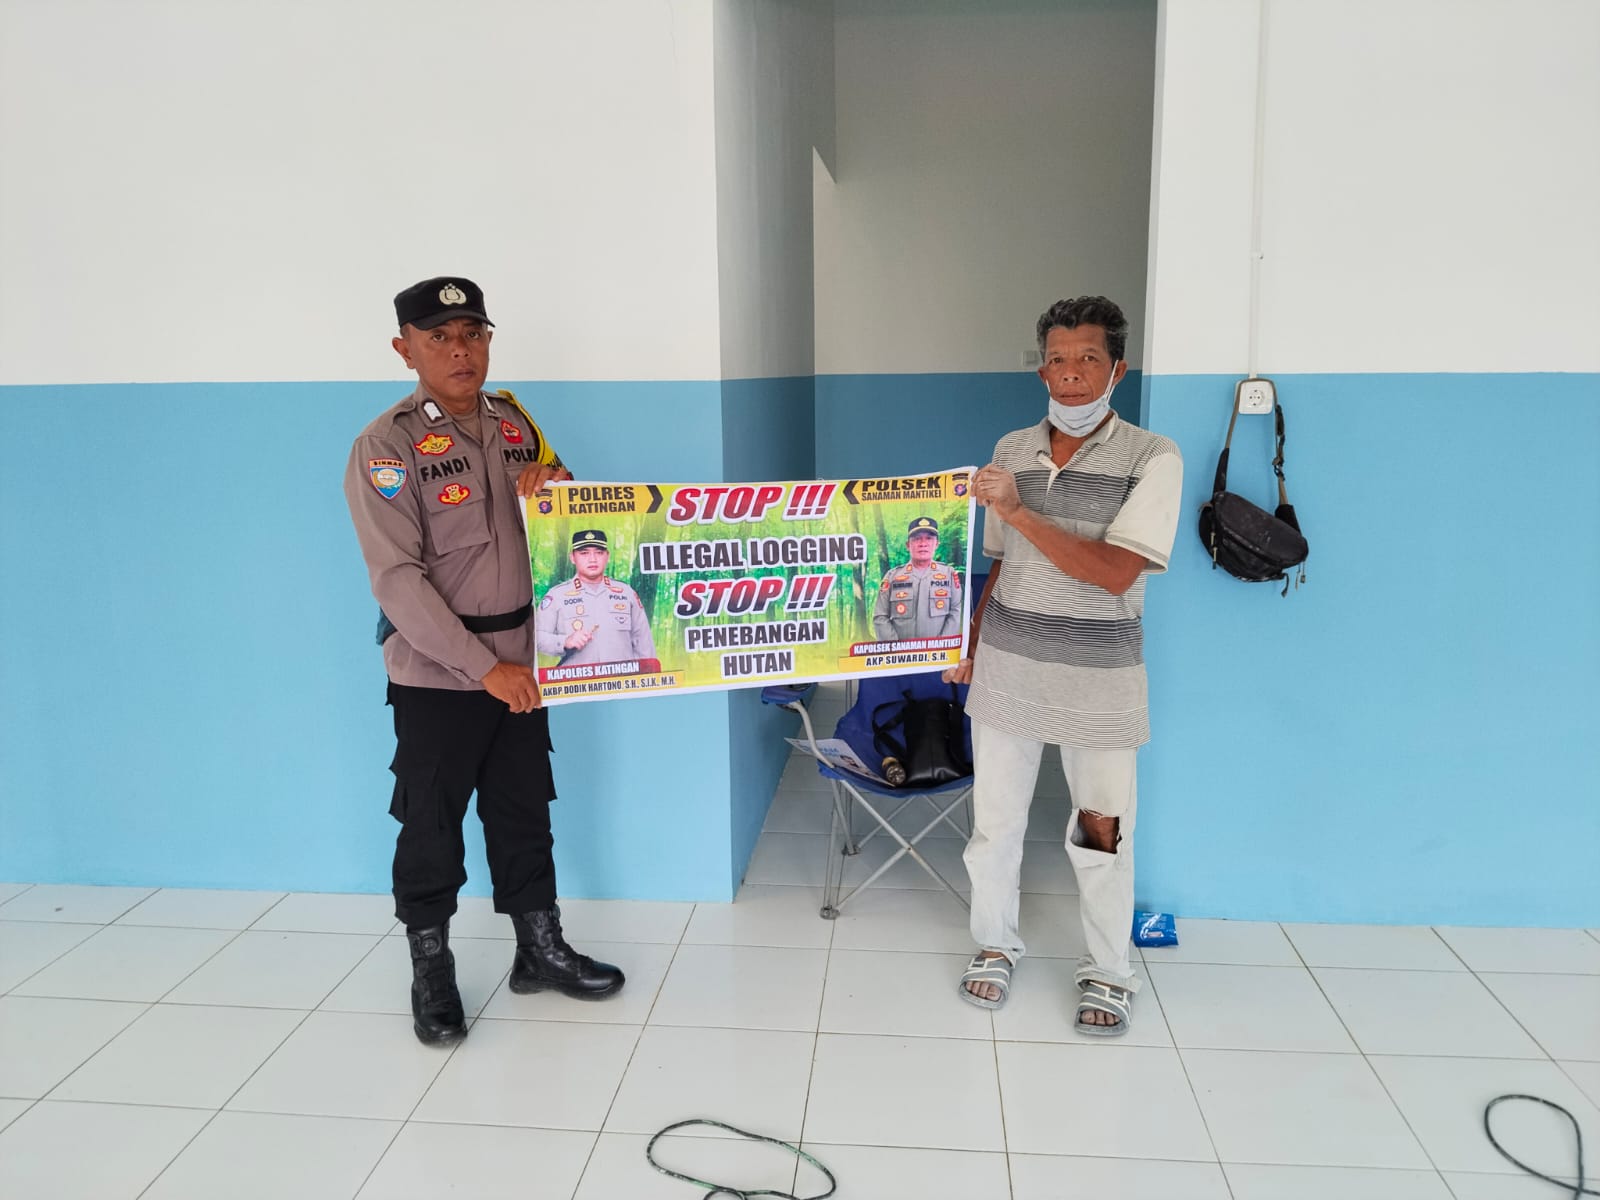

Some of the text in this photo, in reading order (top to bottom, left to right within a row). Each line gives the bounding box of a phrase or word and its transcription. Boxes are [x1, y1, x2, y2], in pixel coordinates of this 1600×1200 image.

[421, 456, 471, 482] FANDI
[862, 476, 941, 492] POLSEK
[568, 486, 634, 502] POLRES
[671, 484, 836, 521] STOP !!!
[862, 489, 941, 501] SANAMAN MANTIKEI
[569, 501, 635, 514] KATINGAN
[643, 536, 864, 571] ILLEGAL LOGGING
[677, 576, 833, 616] STOP !!!
[688, 621, 825, 650] PENEBANGAN
[854, 643, 891, 655] KAPOLSEK
[892, 640, 928, 652] SANAMAN
[724, 652, 792, 677] HUTAN
[866, 657, 883, 667] AKP
[547, 662, 639, 681] KAPOLRES KATINGAN
[564, 683, 587, 695] DODIK
